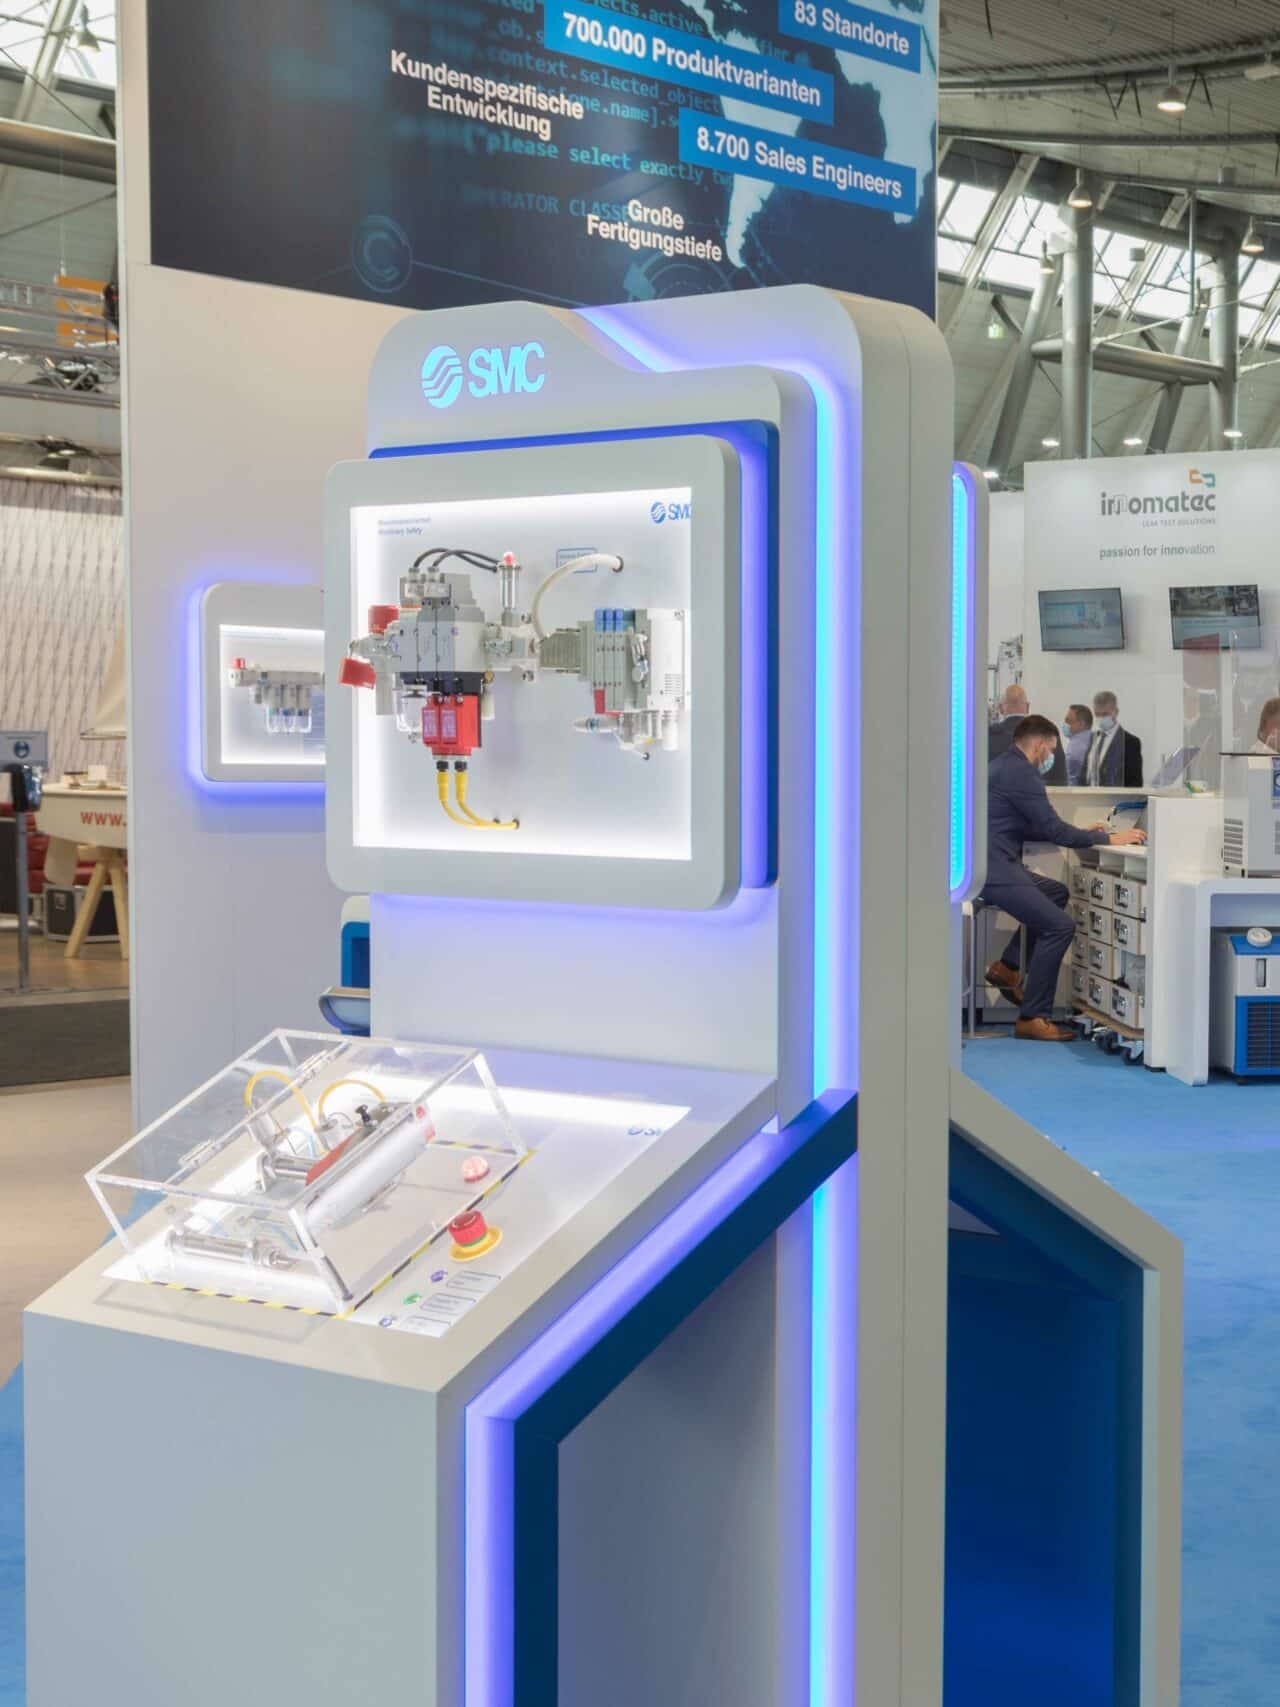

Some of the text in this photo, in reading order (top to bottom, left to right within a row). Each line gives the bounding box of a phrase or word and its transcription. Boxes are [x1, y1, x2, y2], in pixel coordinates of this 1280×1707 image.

[794, 1, 817, 26] 83
[822, 9, 910, 55] Standorte
[391, 49, 584, 120] Kundenspezifische
[563, 11, 646, 59] 700.000
[652, 36, 822, 107] Produktvarianten
[427, 85, 552, 141] Entwicklung
[569, 147, 631, 171] select
[640, 158, 703, 184] exactly
[696, 127, 902, 199] 8.700 Sales Engineers
[587, 213, 722, 262] Fertigungstiefe
[627, 199, 685, 230] Große
[467, 341, 546, 399] SMC
[668, 503, 692, 521] SM
[1099, 543, 1216, 561] passion for innovation
